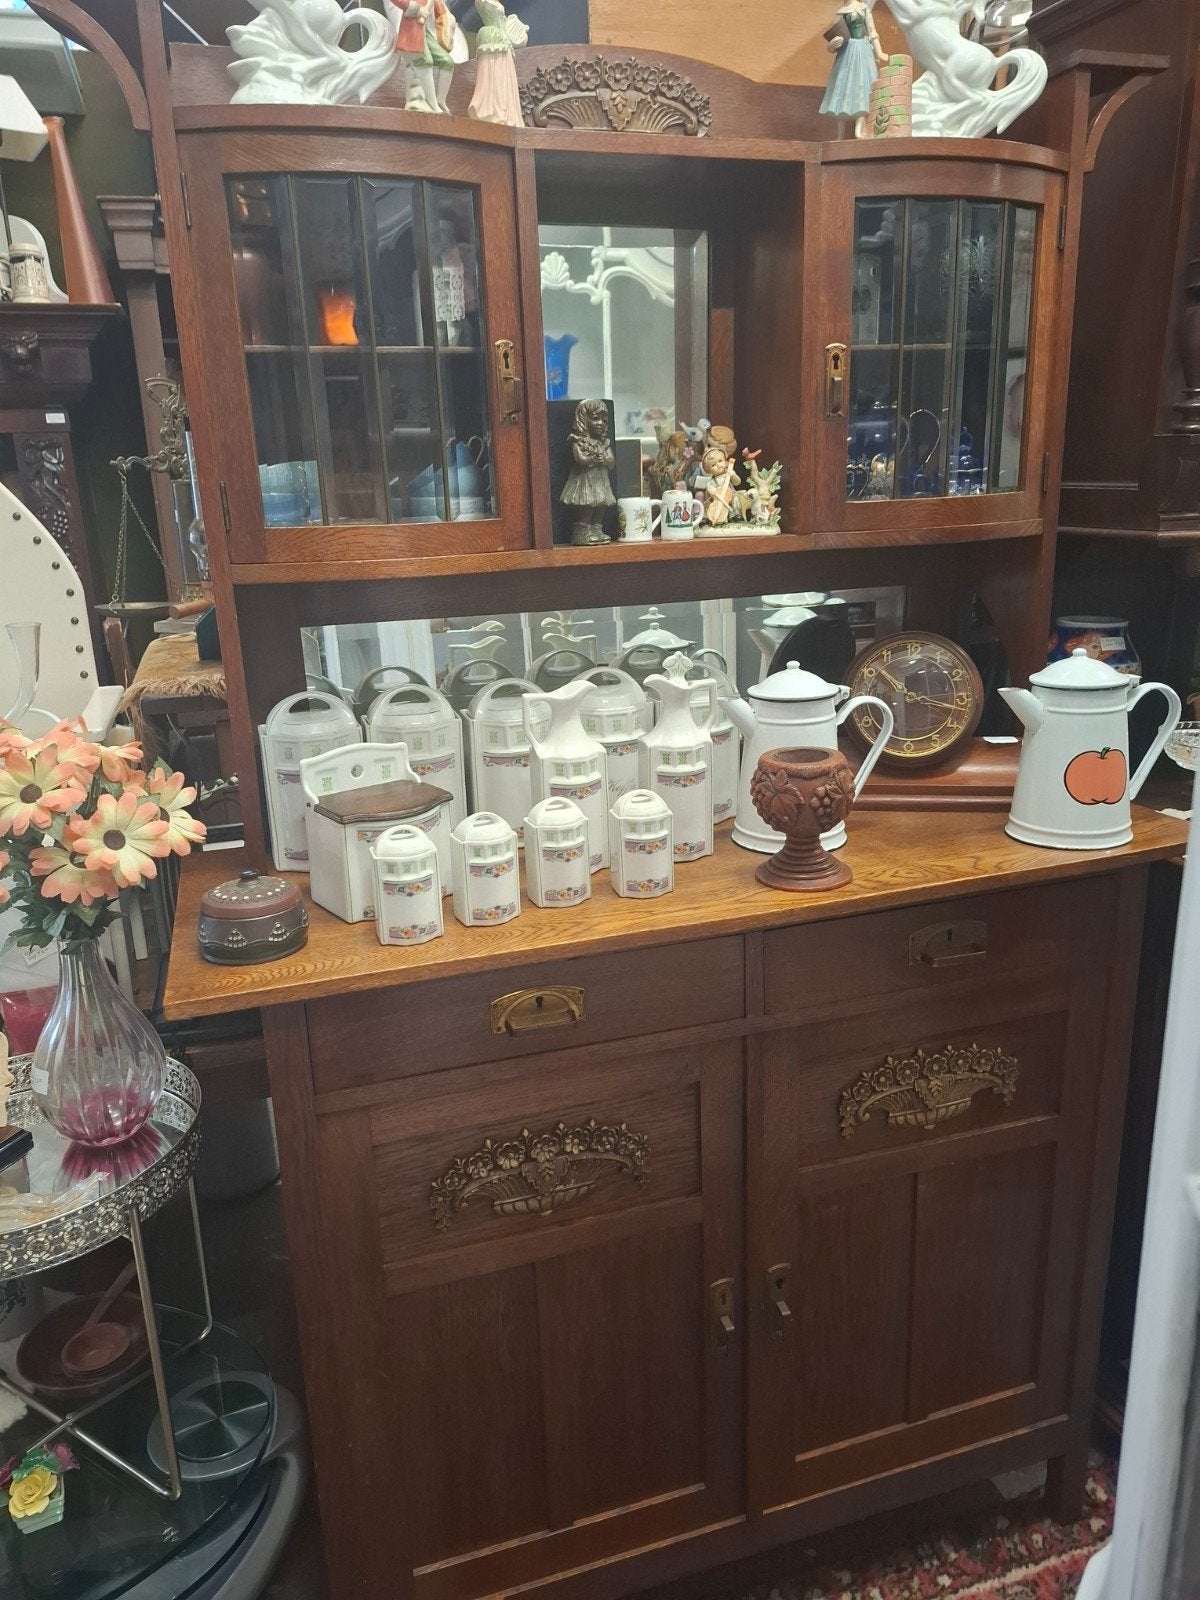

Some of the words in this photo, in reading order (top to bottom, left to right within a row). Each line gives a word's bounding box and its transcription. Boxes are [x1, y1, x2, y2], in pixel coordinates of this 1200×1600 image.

[881, 649, 892, 661] 11
[906, 643, 921, 656] 12
[861, 667, 876, 679] 10
[952, 668, 963, 681] 2
[955, 692, 967, 705] 3
[861, 716, 872, 727] 8
[946, 718, 961, 730] 4
[903, 741, 914, 752] 6
[931, 735, 941, 747] 5
